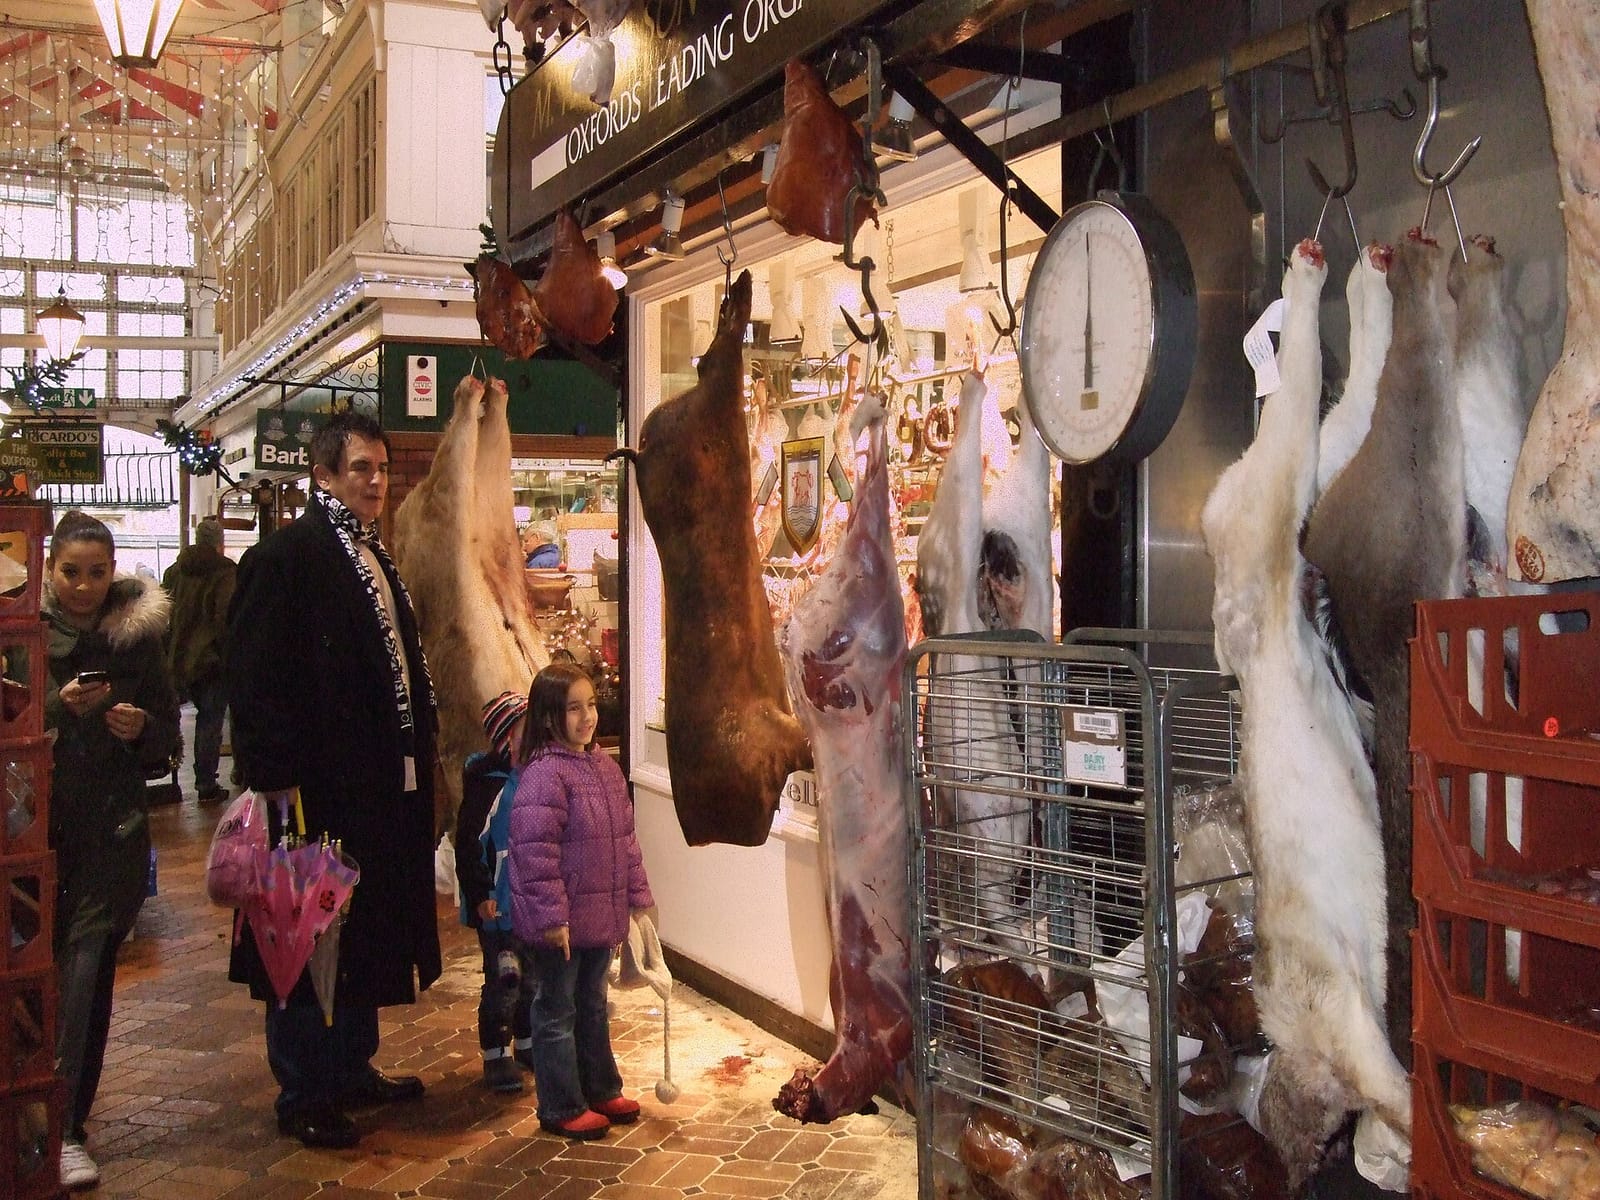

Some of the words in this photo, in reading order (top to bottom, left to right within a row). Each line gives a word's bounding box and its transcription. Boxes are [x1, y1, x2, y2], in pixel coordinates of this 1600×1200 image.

[566, 81, 642, 164] OXFORDS
[648, 13, 734, 113] LEADING
[743, 0, 802, 43] ORG
[1, 455, 38, 468] OXFORD
